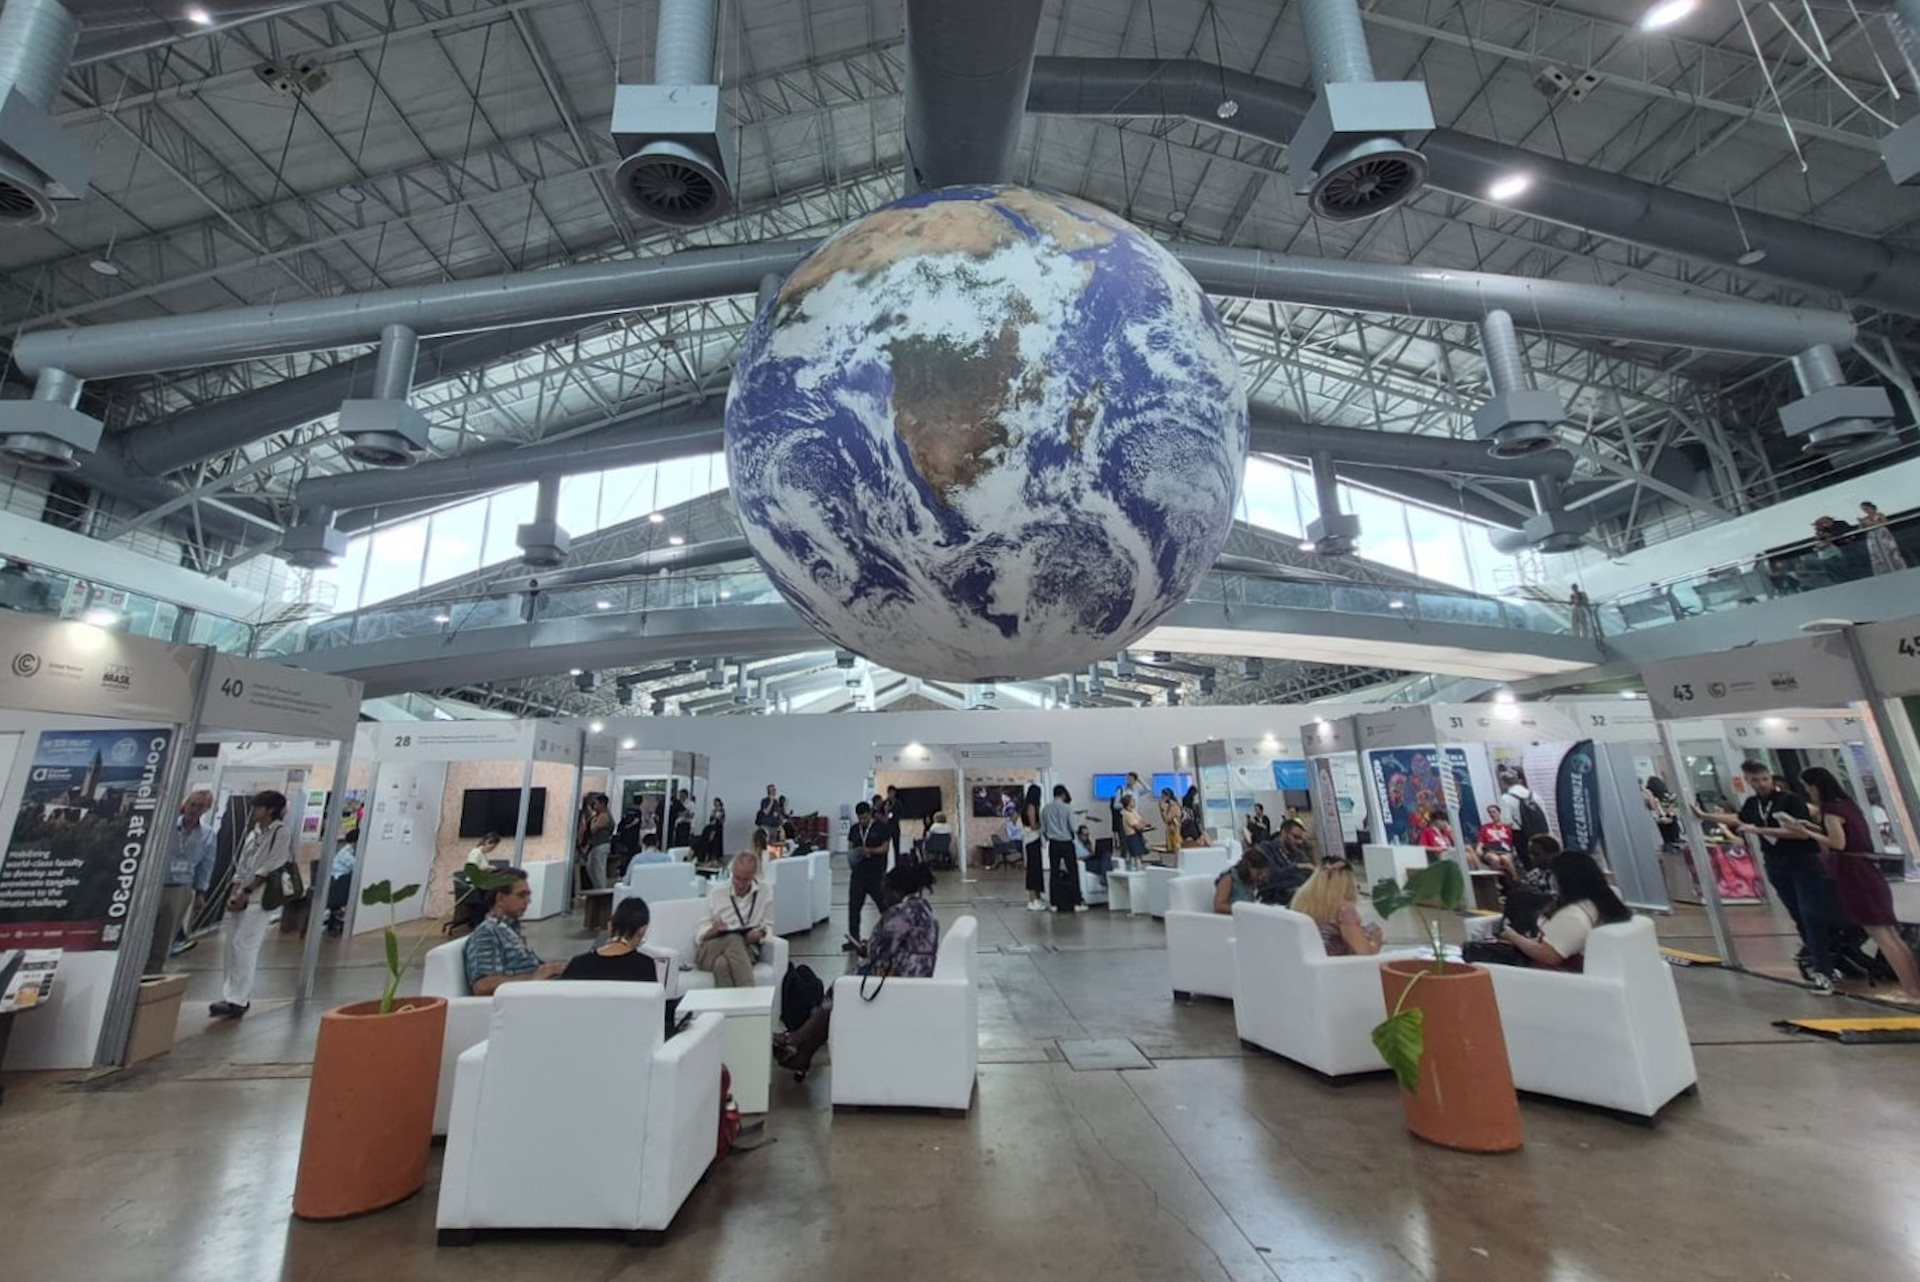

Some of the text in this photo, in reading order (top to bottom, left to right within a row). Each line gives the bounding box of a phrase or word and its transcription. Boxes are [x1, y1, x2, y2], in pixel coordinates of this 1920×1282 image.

[221, 678, 243, 697] 40
[1673, 683, 1694, 701] 43
[1450, 716, 1463, 728] 31
[1590, 715, 1607, 726] 32
[395, 736, 411, 747] 28
[108, 737, 166, 918] Cornell at COP30
[55, 858, 84, 868] faculty
[47, 868, 64, 877] and
